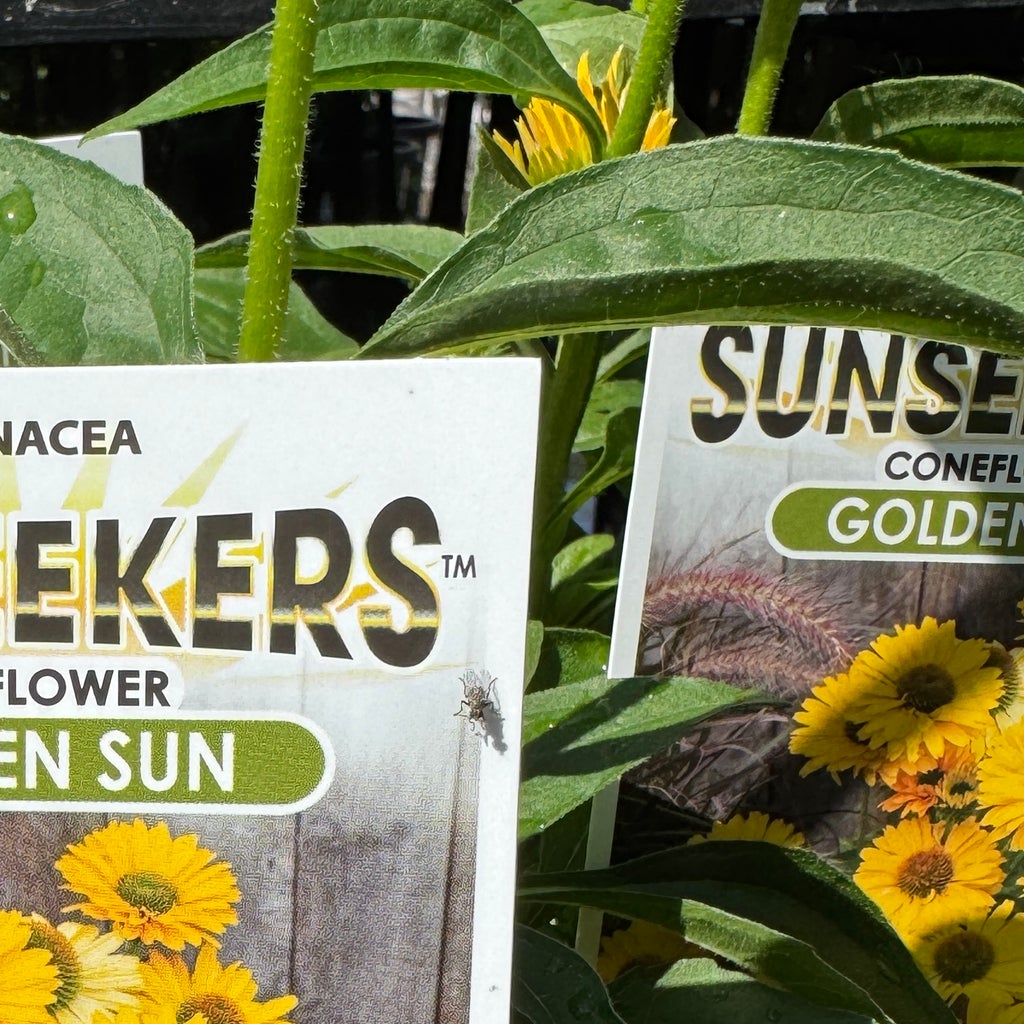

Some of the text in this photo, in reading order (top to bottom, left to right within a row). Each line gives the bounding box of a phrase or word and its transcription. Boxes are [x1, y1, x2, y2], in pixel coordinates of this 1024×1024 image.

[691, 325, 1024, 443] SUNSE
[884, 450, 1024, 484] CONEFL
[96, 729, 237, 793] SUN
